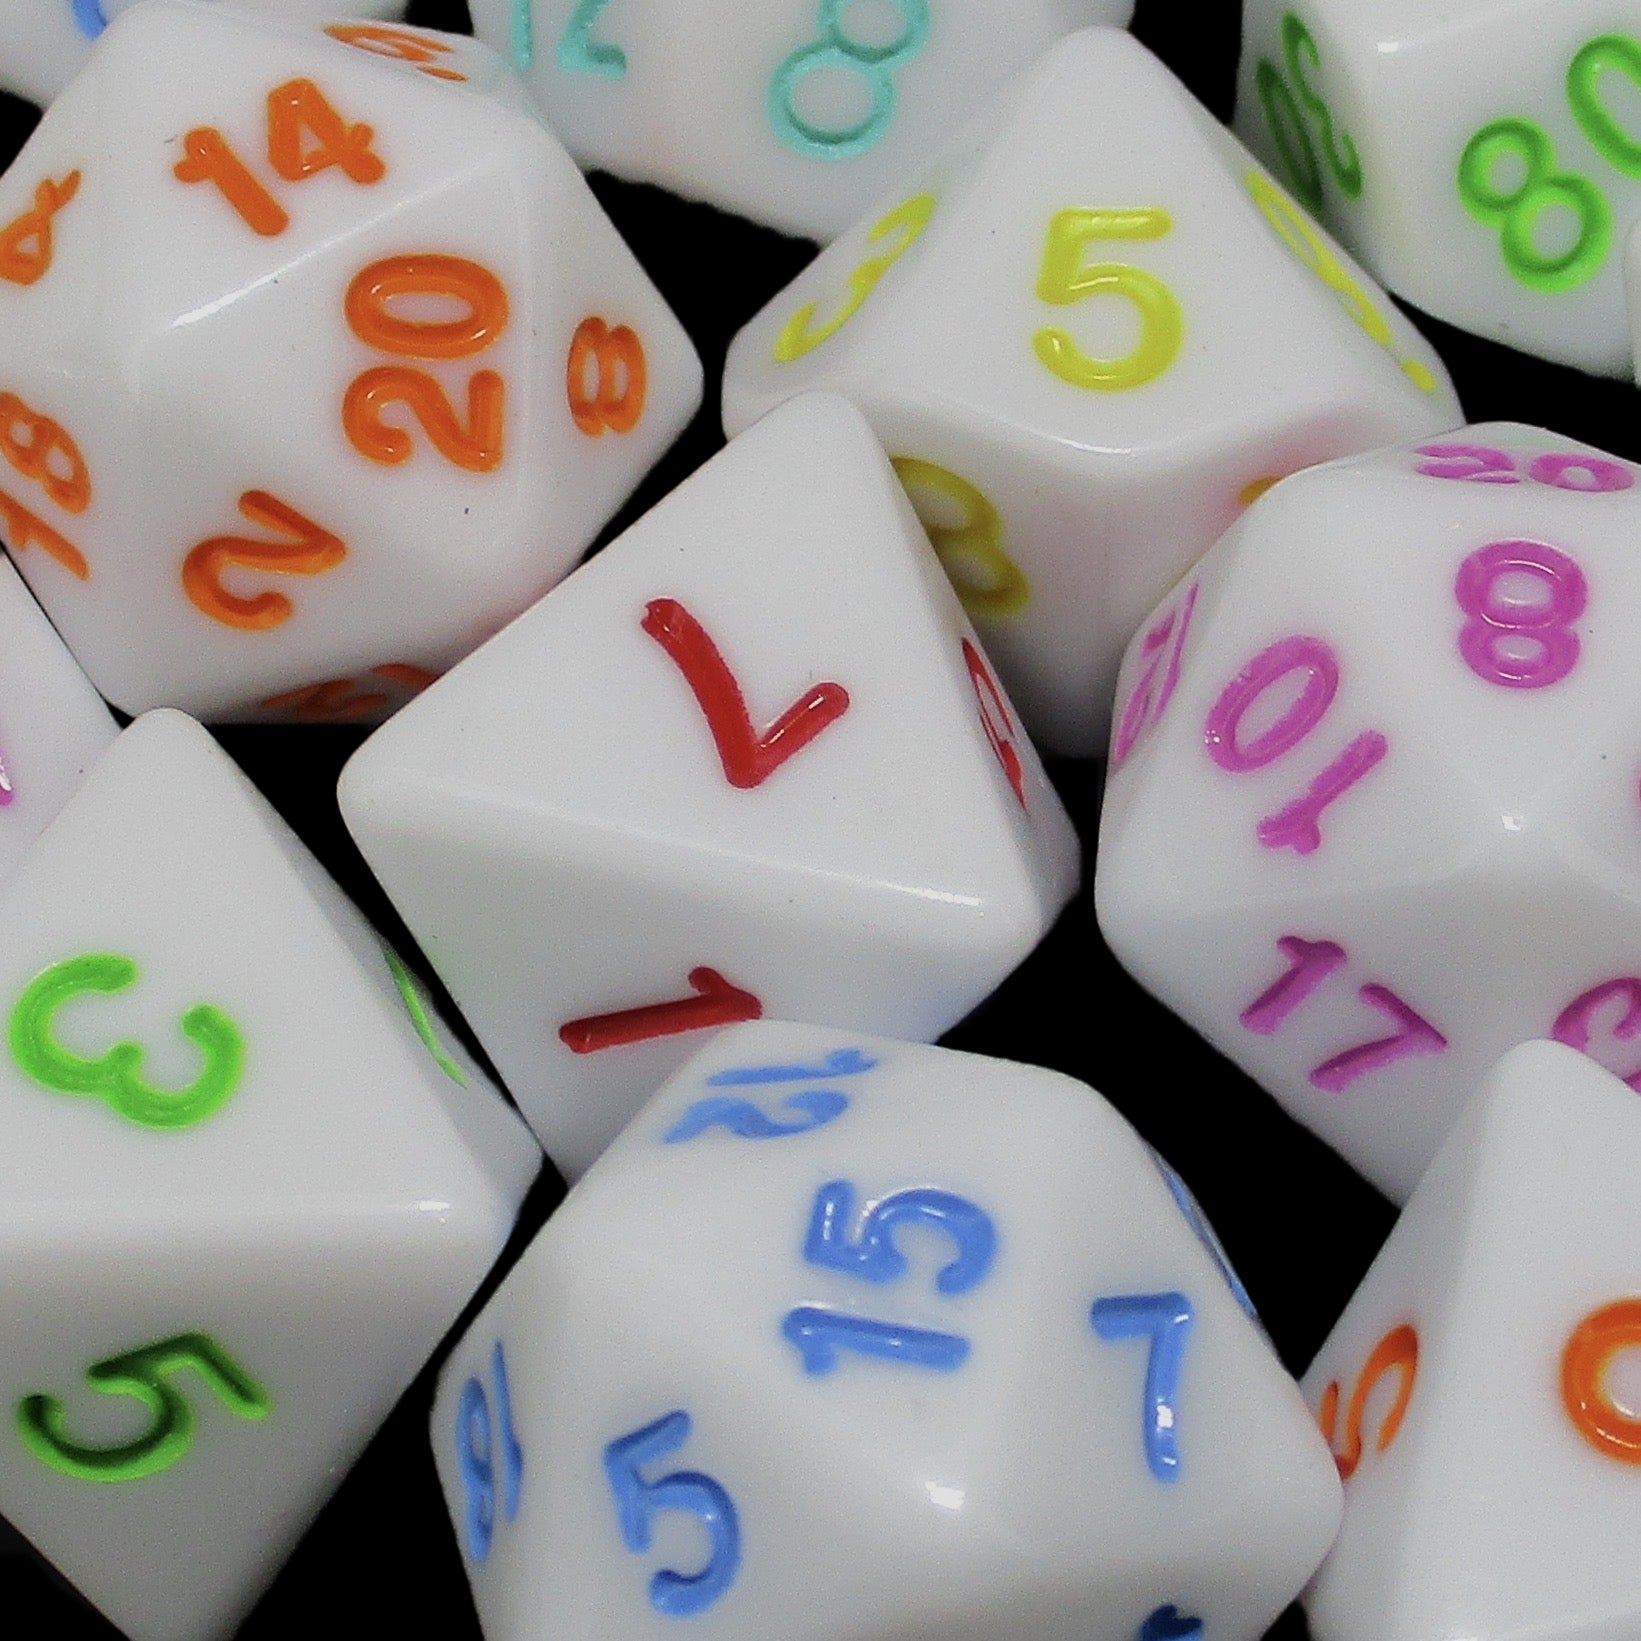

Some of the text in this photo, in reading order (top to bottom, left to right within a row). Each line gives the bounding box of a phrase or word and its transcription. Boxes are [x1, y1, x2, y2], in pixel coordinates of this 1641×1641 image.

[174, 77, 388, 237] 14
[774, 0, 928, 160] 8
[0, 170, 80, 286] 4
[775, 194, 936, 363] 3
[1032, 207, 1184, 392] 5
[343, 252, 511, 473] 20
[566, 316, 648, 437] 8
[0, 390, 92, 580] 18
[1414, 443, 1635, 493] 20
[181, 489, 348, 633] 2
[1456, 541, 1588, 689] 8
[641, 597, 849, 789] 7
[1204, 634, 1389, 855] 10
[8, 953, 247, 1131] 3
[560, 966, 763, 1054] 1
[1239, 934, 1447, 1092] 17
[664, 1048, 876, 1144] 12
[782, 1180, 1001, 1377] 15
[17, 1331, 273, 1483] 5
[457, 1341, 523, 1563] 18
[1089, 1291, 1194, 1484] 7
[602, 1409, 742, 1618] 5
